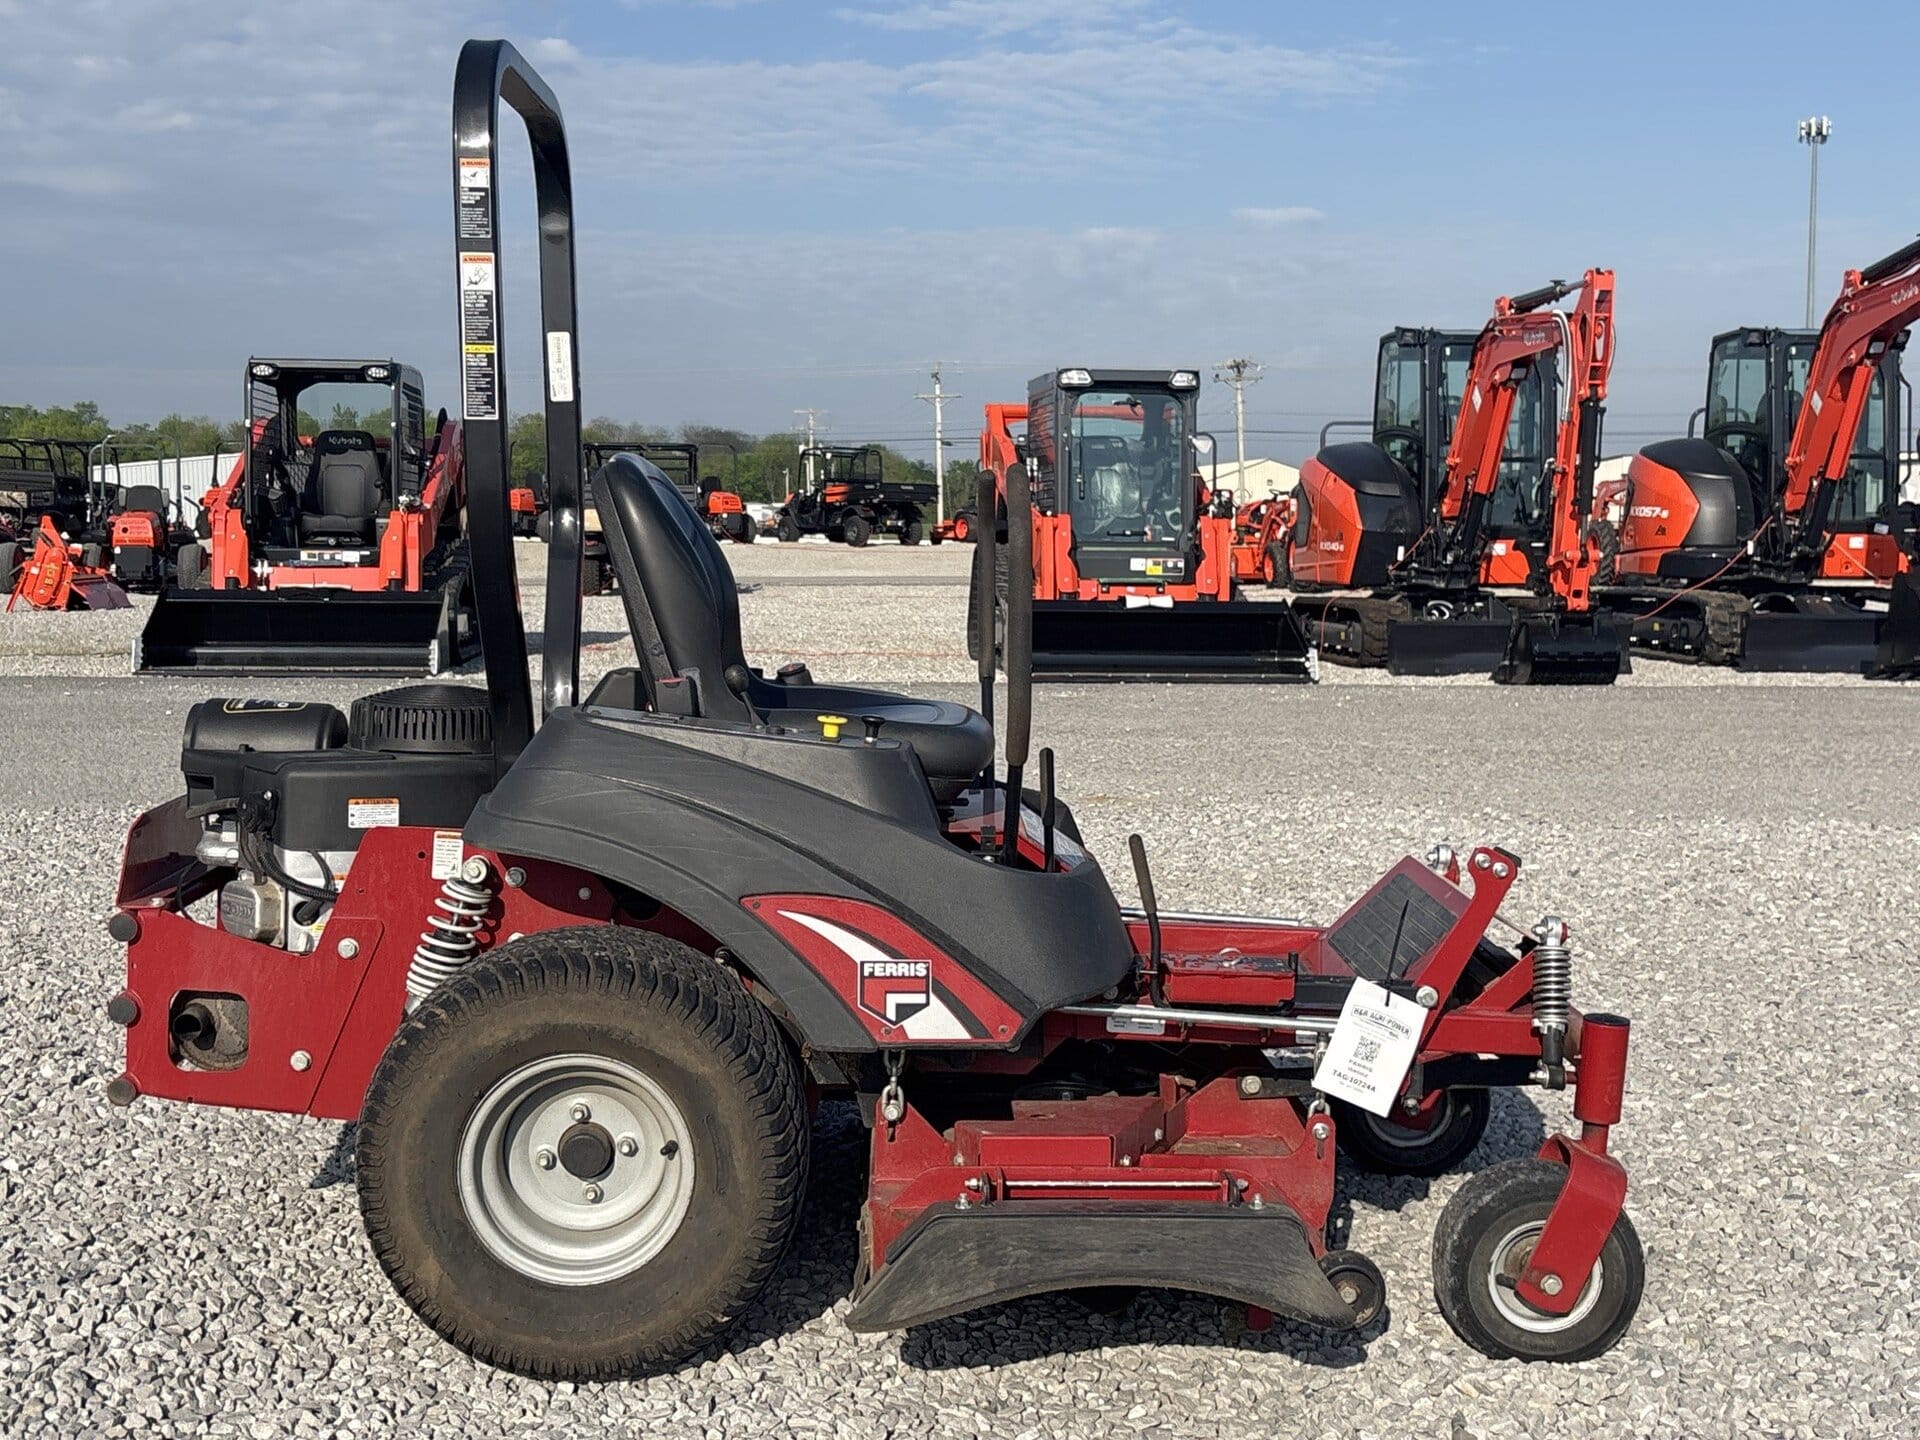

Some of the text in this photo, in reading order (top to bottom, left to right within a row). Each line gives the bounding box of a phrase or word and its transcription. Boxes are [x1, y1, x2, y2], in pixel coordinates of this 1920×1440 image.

[328, 436, 362, 445] Kubota
[863, 962, 927, 977] FERRIS
[1386, 1018, 1410, 1036] POWER
